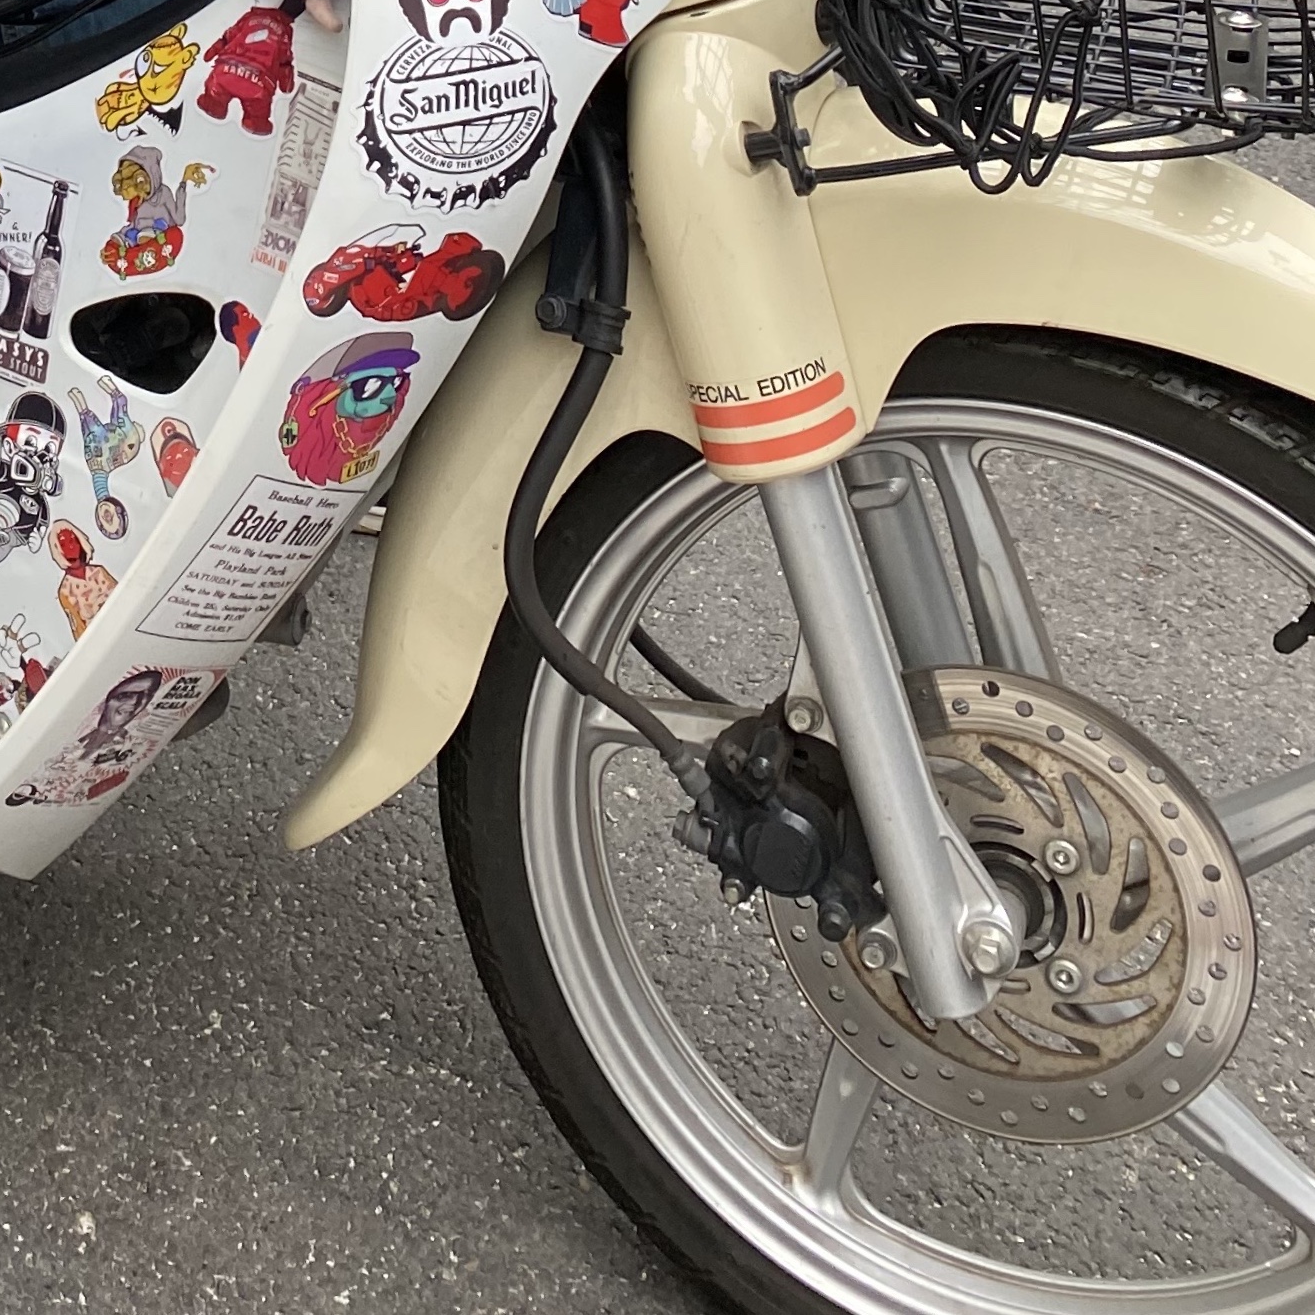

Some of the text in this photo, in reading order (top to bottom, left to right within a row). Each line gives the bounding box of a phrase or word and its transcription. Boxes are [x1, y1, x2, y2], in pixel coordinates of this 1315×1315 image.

[396, 44, 433, 75] CERVEZA
[405, 143, 453, 169] EXPLORING
[456, 161, 472, 169] THE
[474, 149, 505, 166] WORLD
[504, 131, 525, 152] SINCE
[9, 357, 43, 380] STOUT
[756, 356, 827, 397] EDITION
[268, 490, 340, 509] Baseball Hero
[227, 504, 335, 547] Babe Ruth
[187, 571, 239, 587] SATURDAY
[214, 559, 287, 576] Playland Park
[174, 621, 203, 631] COME
